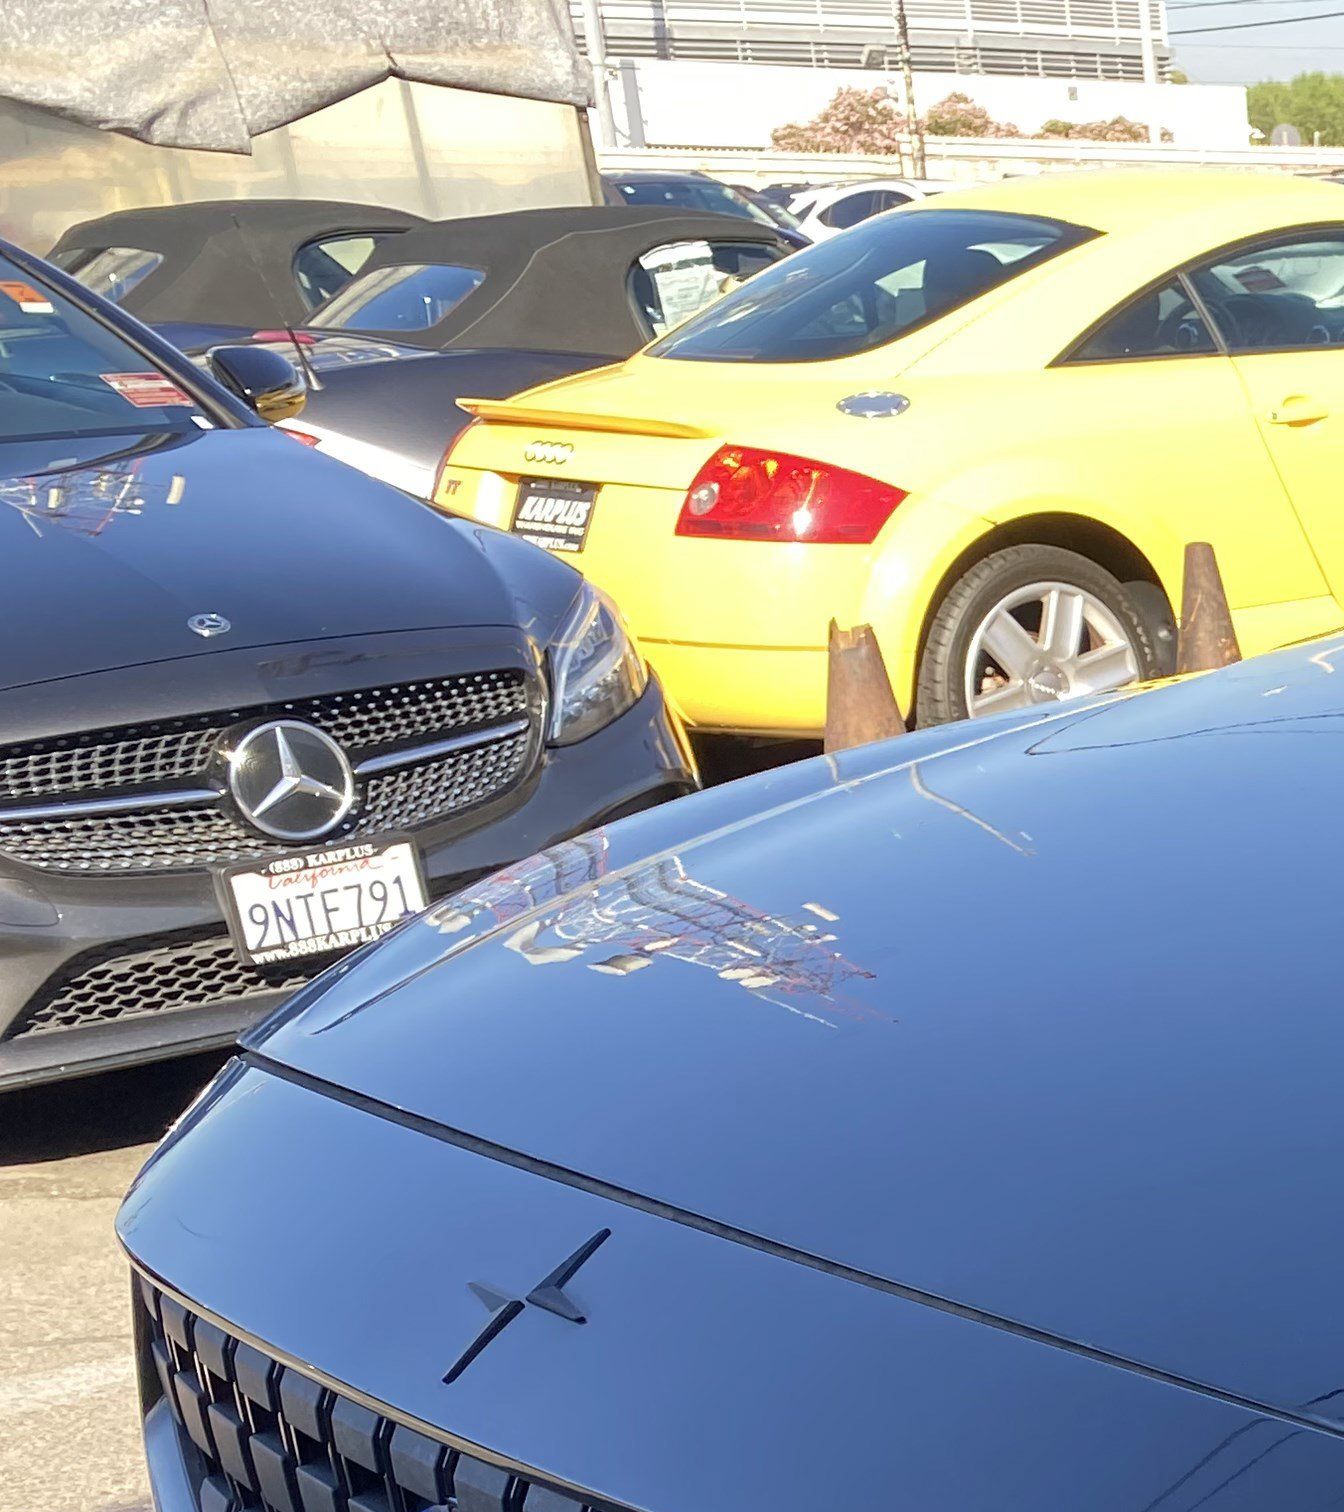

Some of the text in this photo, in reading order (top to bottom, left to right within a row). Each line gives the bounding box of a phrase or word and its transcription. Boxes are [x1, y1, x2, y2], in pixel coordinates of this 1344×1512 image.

[518, 496, 591, 526] KARPLUS
[267, 857, 384, 889] California
[268, 844, 376, 874] (888) KARPLUS
[248, 875, 416, 950] 9NTF791
